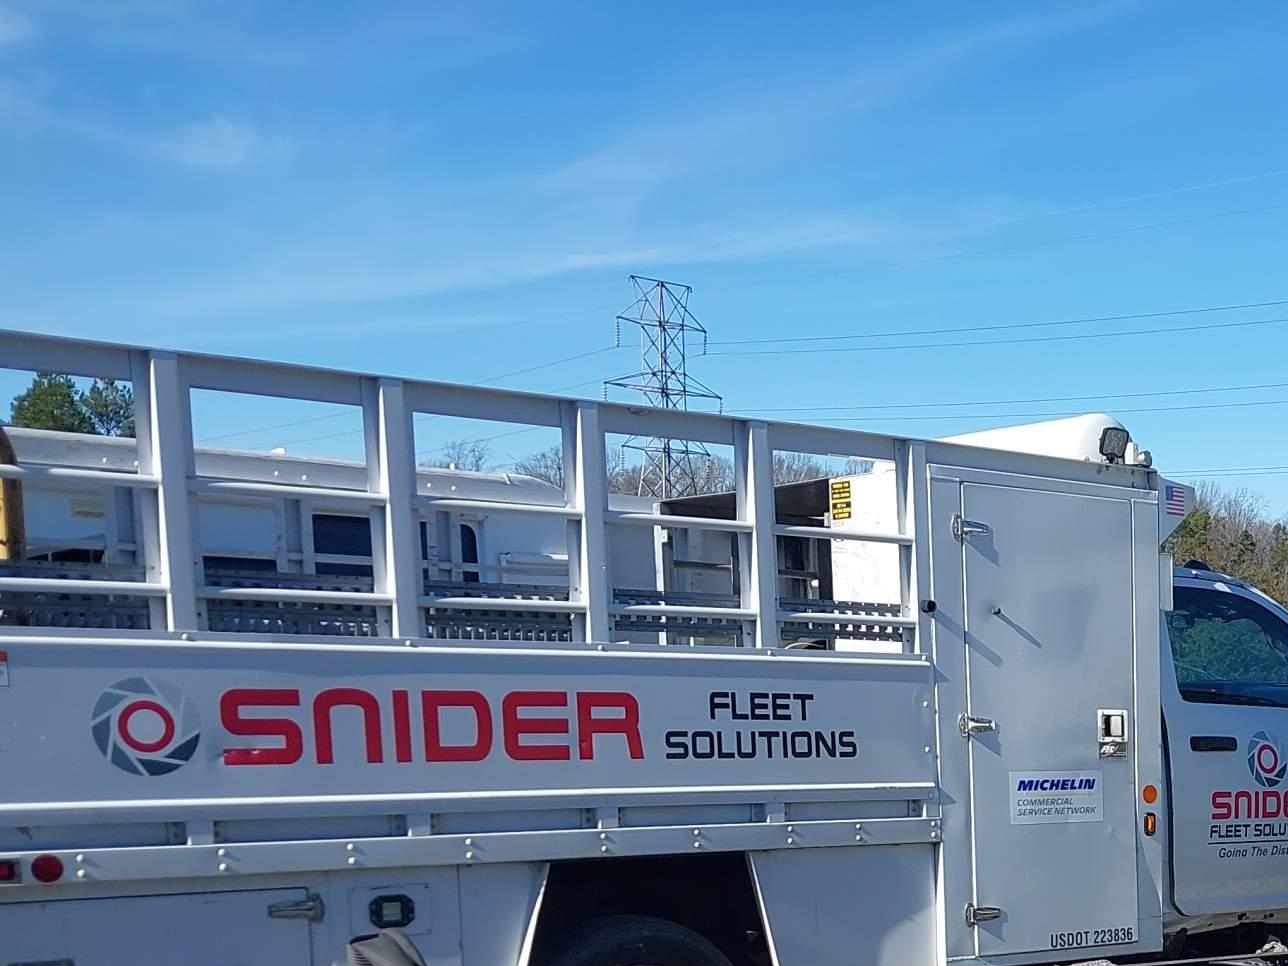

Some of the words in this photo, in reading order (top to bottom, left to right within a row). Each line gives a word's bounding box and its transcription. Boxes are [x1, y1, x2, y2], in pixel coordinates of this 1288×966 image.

[709, 691, 814, 721] FLEET
[220, 688, 645, 765] SNIDER
[665, 730, 858, 760] SOLUTIONS
[1017, 779, 1096, 791] MICHELIN
[1017, 798, 1073, 807] COMMERCIAL
[1017, 807, 1053, 816] SERVICE
[1054, 806, 1096, 815] NETWORK
[1210, 824, 1251, 839] FLEET
[1251, 846, 1268, 857] The
[1050, 931, 1090, 948] USDOT
[1094, 927, 1133, 944] 223836
